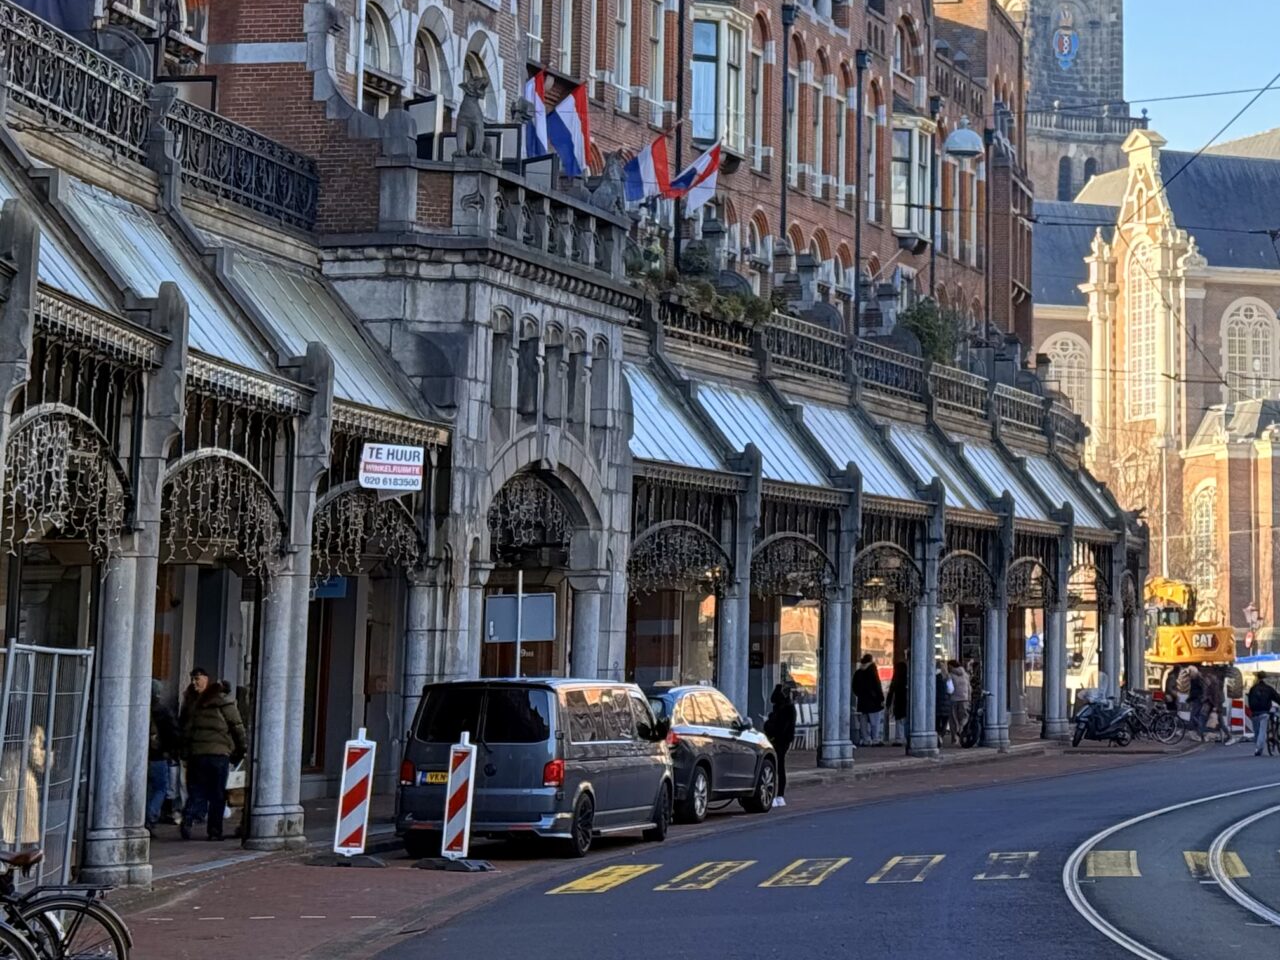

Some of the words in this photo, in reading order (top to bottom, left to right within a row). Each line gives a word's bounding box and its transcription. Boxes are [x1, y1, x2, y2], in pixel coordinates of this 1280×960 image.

[368, 446, 383, 460] TE
[387, 448, 421, 462] HUUR
[364, 476, 380, 485] 020
[1192, 633, 1214, 648] CAT
